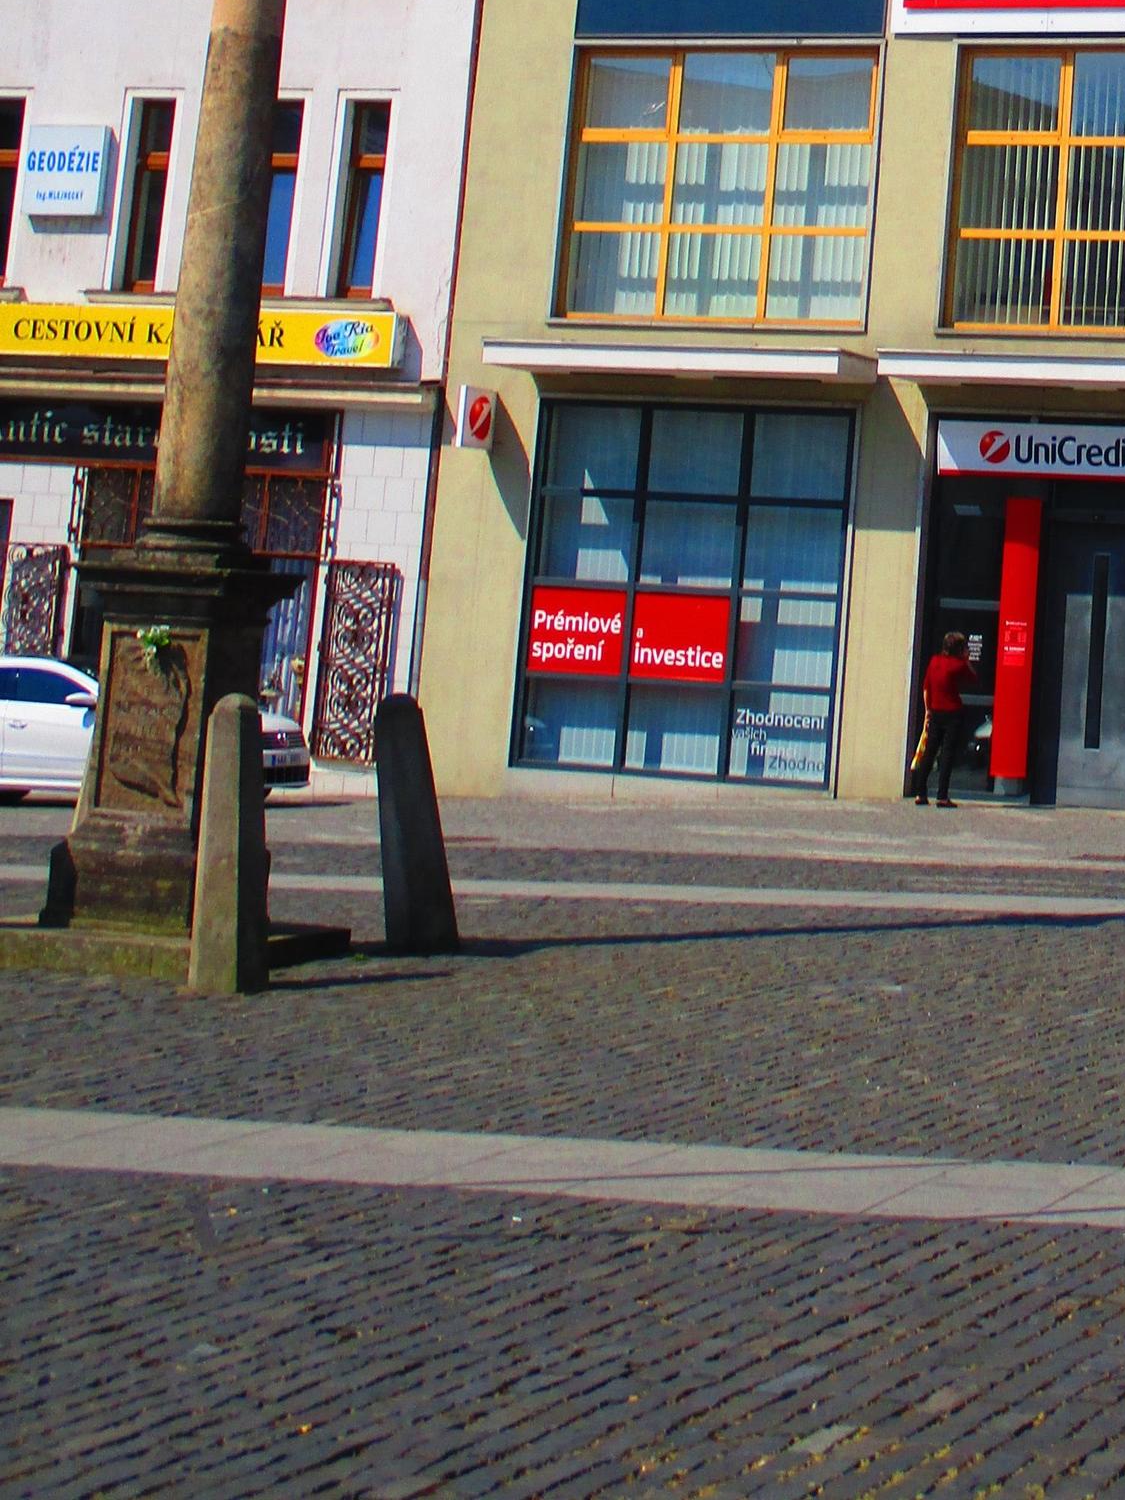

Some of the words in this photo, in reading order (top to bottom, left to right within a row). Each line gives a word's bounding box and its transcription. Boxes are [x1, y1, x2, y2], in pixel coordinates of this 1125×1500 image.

[27, 145, 100, 172] GEODÉZIE
[13, 316, 137, 344] CESTOVNÍ
[0, 411, 68, 444] ntic
[534, 609, 622, 634] Prémiové
[636, 627, 644, 638] a
[531, 638, 605, 662] spoření
[634, 642, 724, 668] investice
